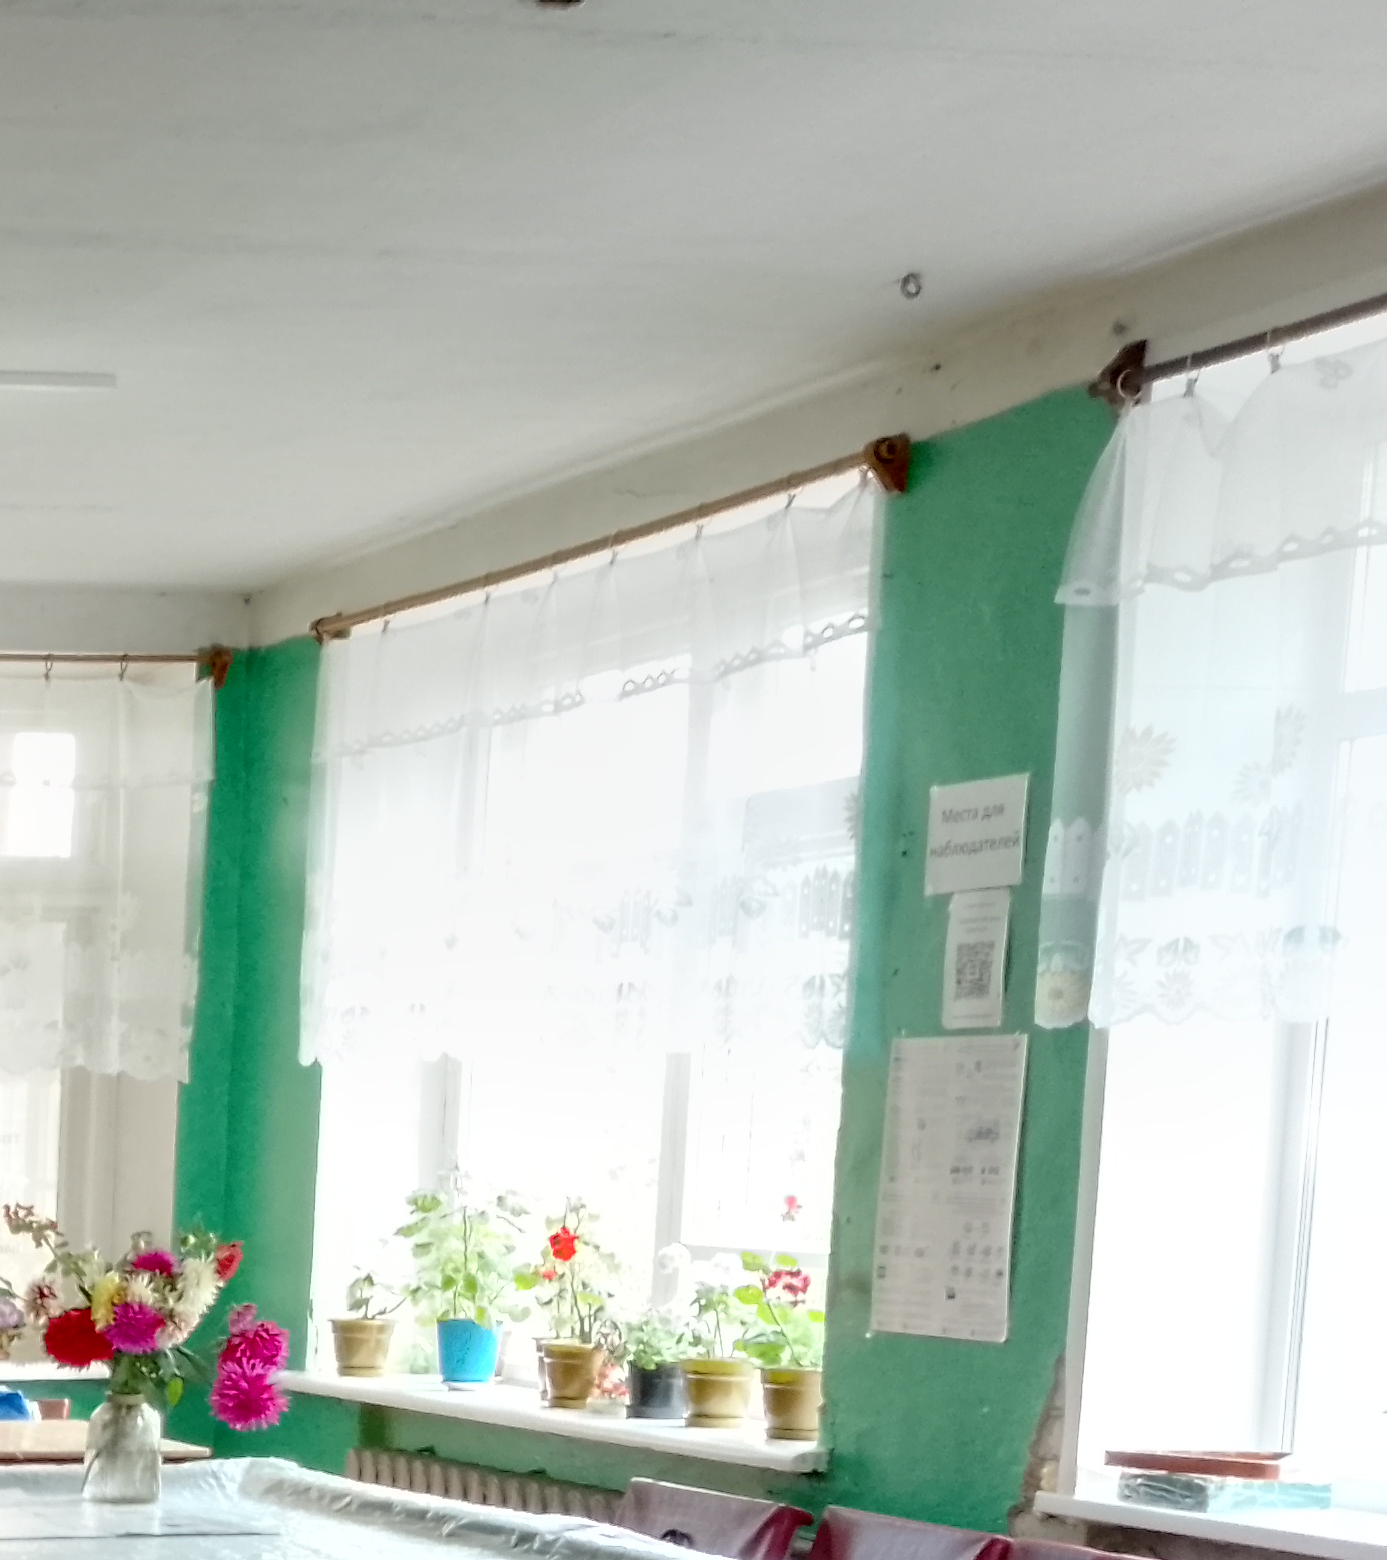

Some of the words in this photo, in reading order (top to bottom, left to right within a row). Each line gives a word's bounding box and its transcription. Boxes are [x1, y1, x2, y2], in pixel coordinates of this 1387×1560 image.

[941, 808, 979, 824] Места
[980, 803, 1005, 821] для
[929, 830, 1020, 858] наблюдателей
